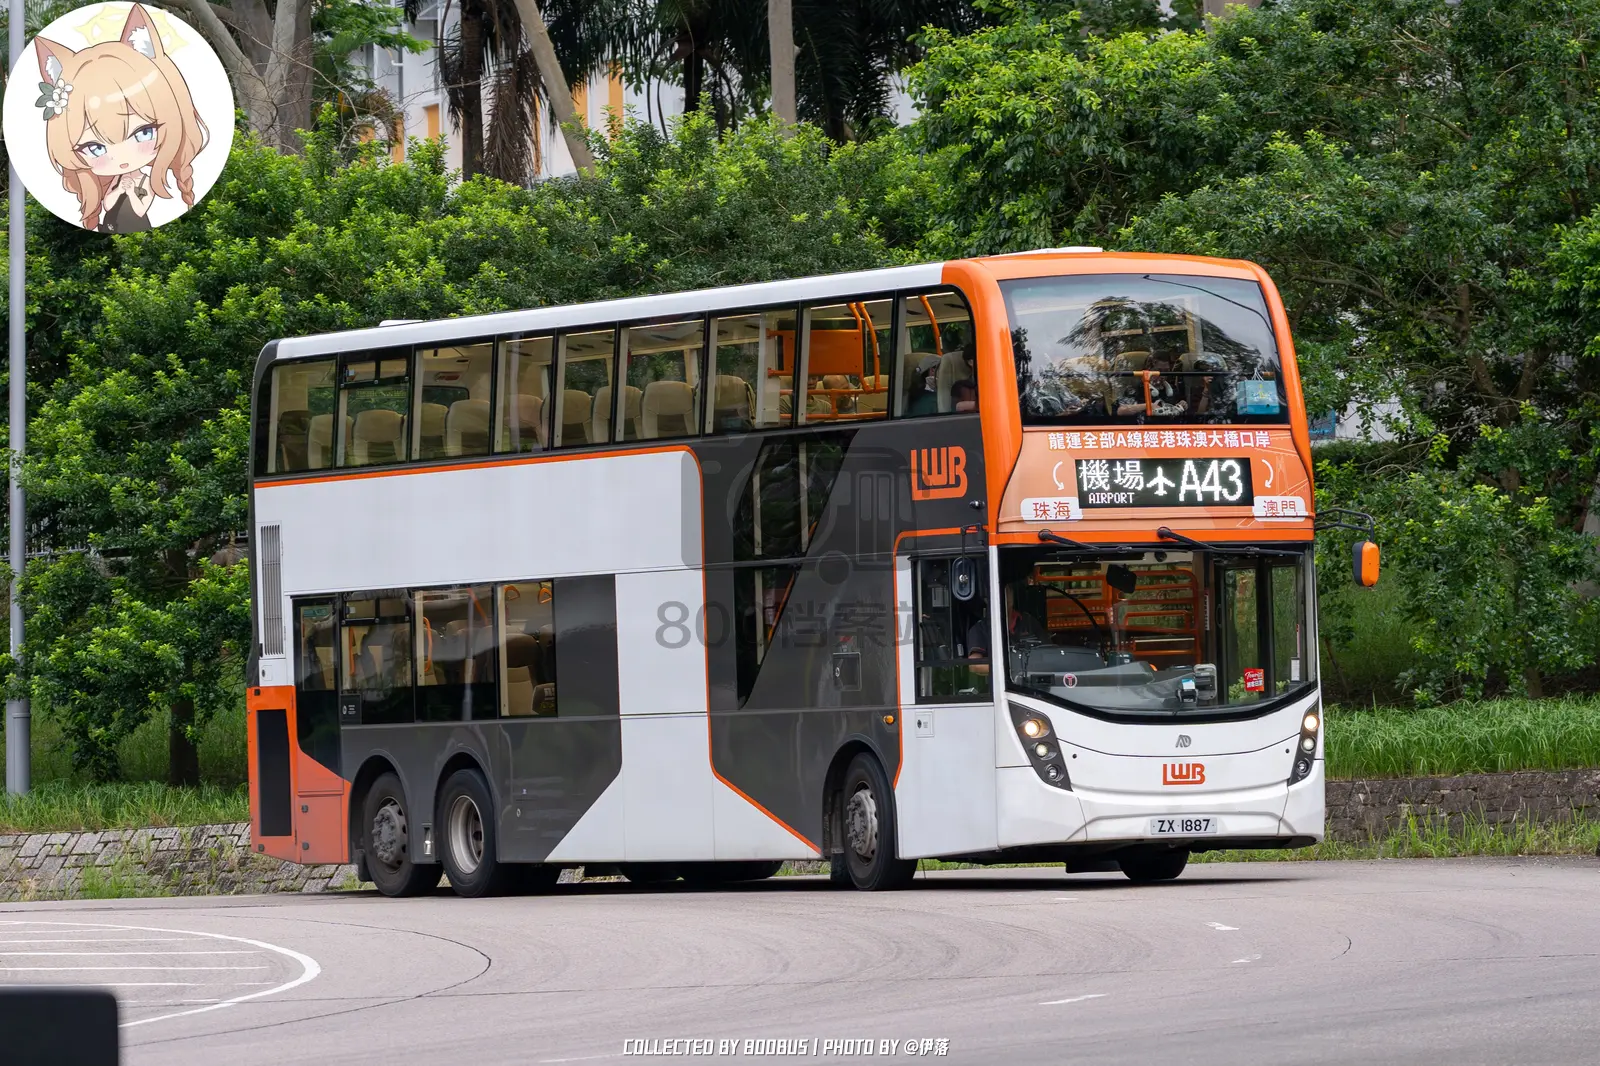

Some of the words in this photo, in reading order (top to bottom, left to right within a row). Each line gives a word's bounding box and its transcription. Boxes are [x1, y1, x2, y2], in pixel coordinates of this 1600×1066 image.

[1047, 430, 1271, 450] 龍運全部A線經港珠澳大橋口岸
[911, 446, 967, 500] LWB
[1078, 459, 1145, 491] 機場
[1179, 459, 1243, 502] A43
[1088, 492, 1135, 504] AIRPORT
[1032, 501, 1071, 520] 珠海
[1263, 500, 1298, 518] 澳門
[1162, 763, 1206, 786] LWB
[1158, 820, 1175, 832] ZX
[1181, 818, 1211, 832] 1887
